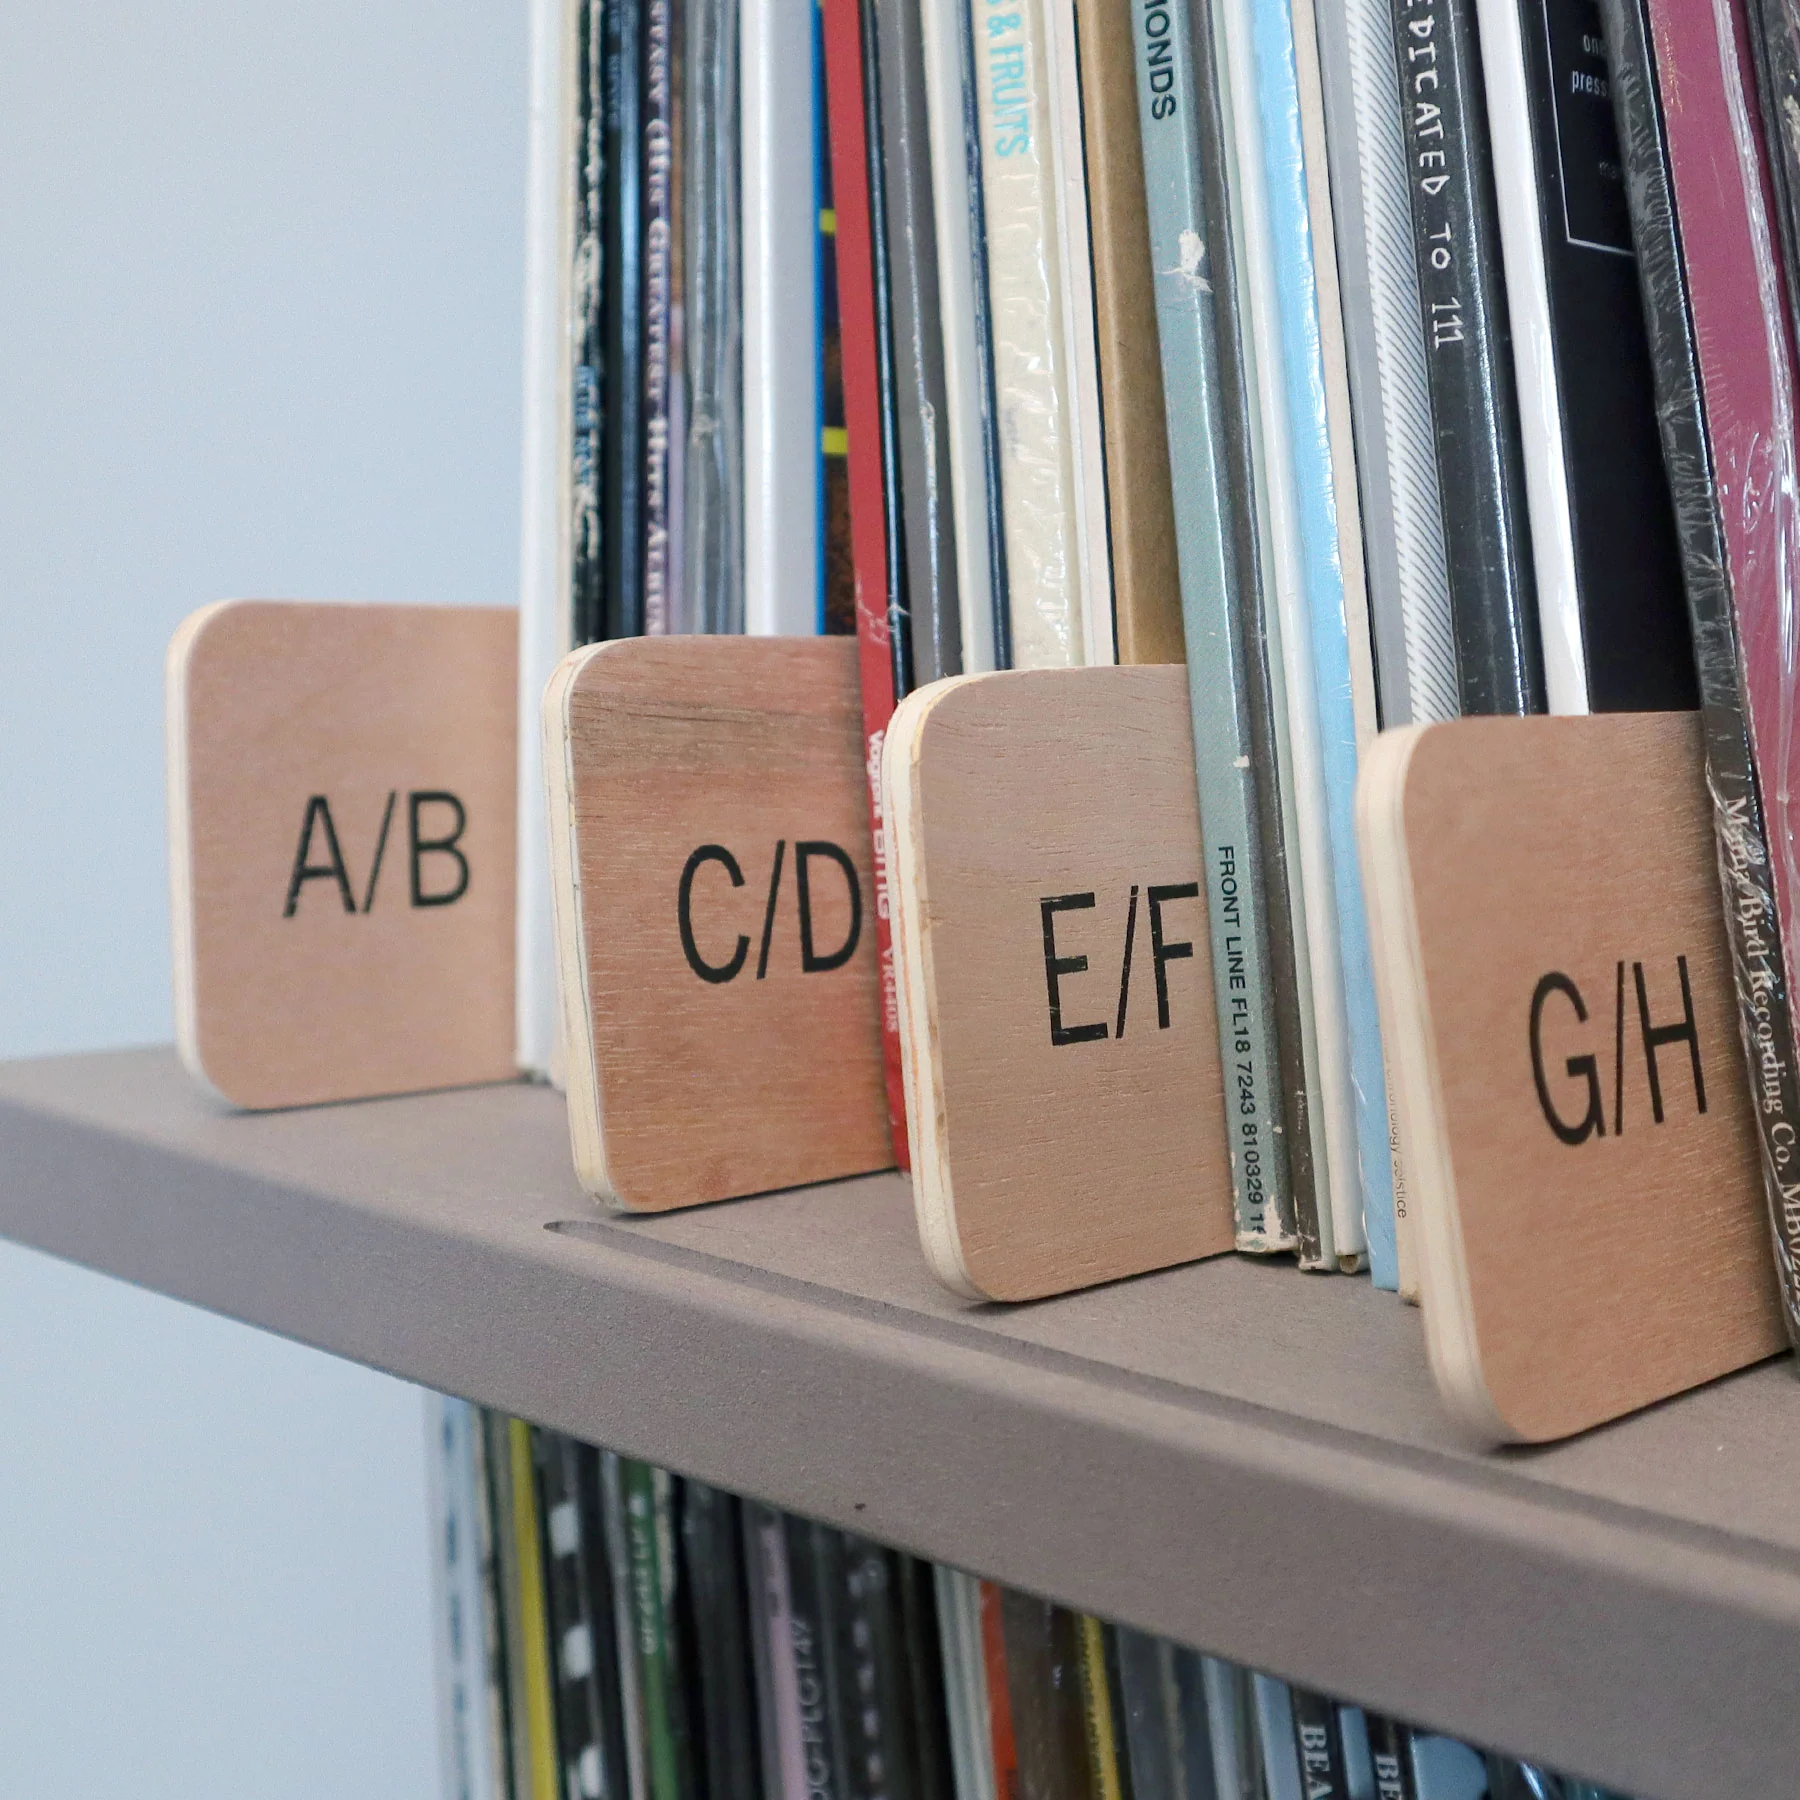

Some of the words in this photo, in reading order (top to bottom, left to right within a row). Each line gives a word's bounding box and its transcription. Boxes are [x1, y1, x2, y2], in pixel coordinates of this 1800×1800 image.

[987, 12, 1022, 38] &
[1145, 0, 1177, 120] ONDS
[989, 44, 1030, 157] FRUITS
[1407, 0, 1450, 196] DICATED
[1430, 222, 1451, 270] TO
[1431, 297, 1465, 350] 111
[282, 789, 470, 918] A/B
[1218, 846, 1240, 928] FRONT
[677, 839, 862, 984] C/D
[1739, 898, 1770, 959] Bird
[1040, 882, 1199, 1046] E/F
[1226, 936, 1246, 990] LINE
[1232, 998, 1251, 1054] FL18
[1530, 955, 1708, 1147] G/H
[1751, 970, 1787, 1114] Recording
[1237, 1061, 1256, 1115] 7243
[1242, 1123, 1264, 1205] 810329
[1771, 1121, 1797, 1171] Co.
